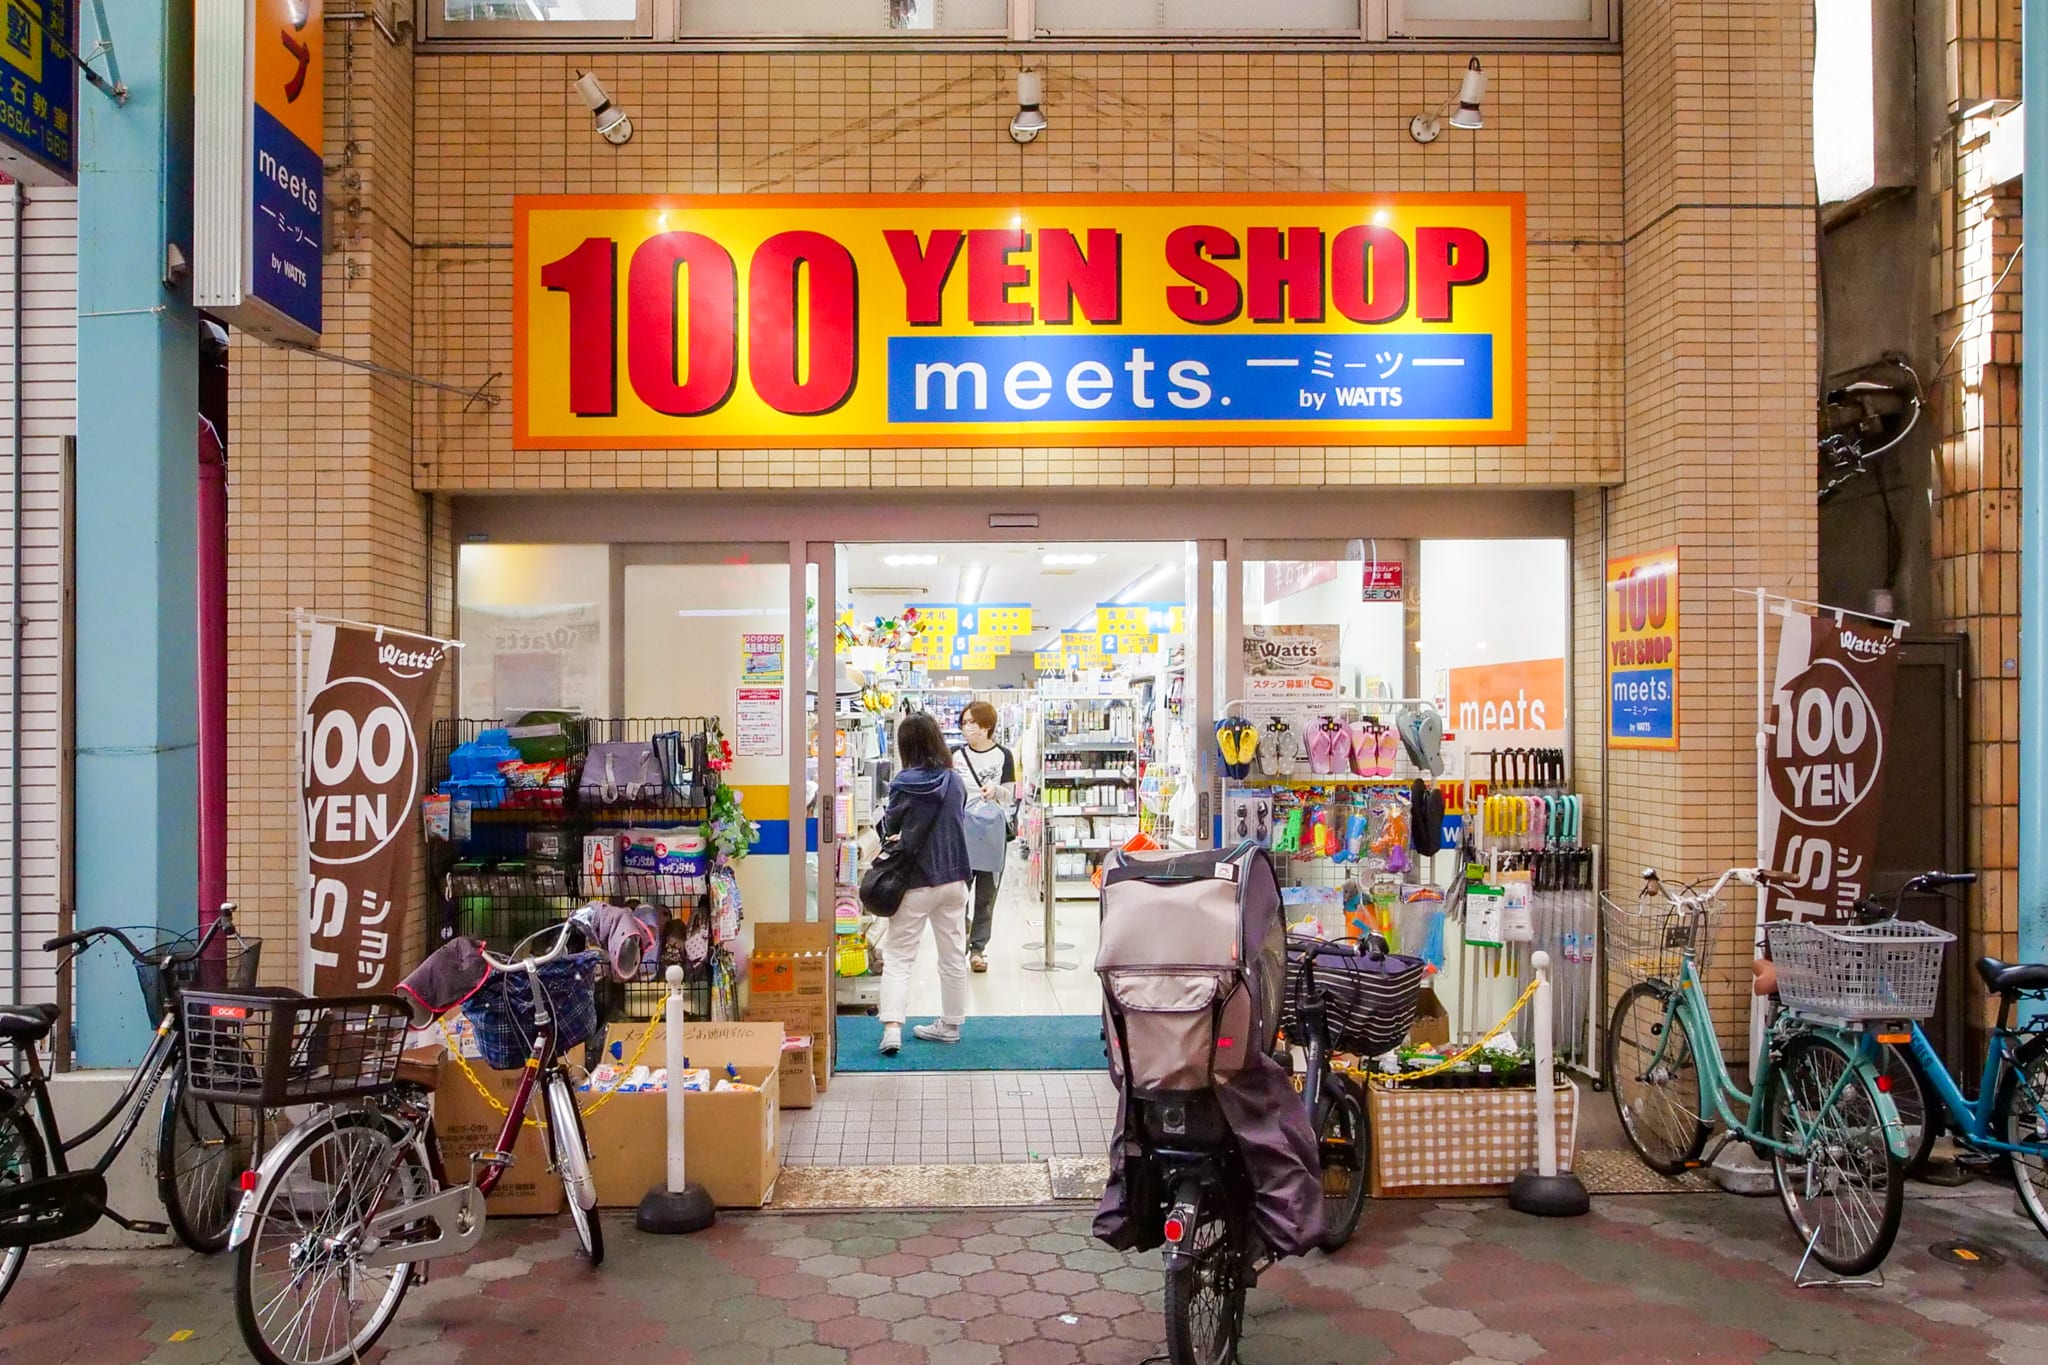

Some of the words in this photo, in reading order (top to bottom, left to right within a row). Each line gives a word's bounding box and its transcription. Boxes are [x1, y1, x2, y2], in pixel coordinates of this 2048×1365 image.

[271, 253, 282, 271] by
[283, 259, 307, 288] WATTS
[541, 230, 860, 417] 100
[883, 229, 1122, 326] YEN
[1165, 225, 1489, 324] SHOP
[1300, 389, 1326, 411] by
[1336, 387, 1403, 406] WATTS
[1615, 562, 1667, 633] 100
[962, 612, 974, 630] 4
[379, 644, 434, 669] Watts
[956, 637, 966, 651] 5
[1104, 636, 1114, 650] 2
[1260, 642, 1317, 657] Watts
[1611, 639, 1636, 666] YEN
[1636, 636, 1673, 665] SHOP
[1839, 630, 1887, 656] Watts
[1460, 688, 1545, 730] meets
[1773, 686, 1867, 758] 100
[303, 705, 406, 787] 100
[1785, 763, 1855, 808] YEN
[308, 793, 388, 843] YEN
